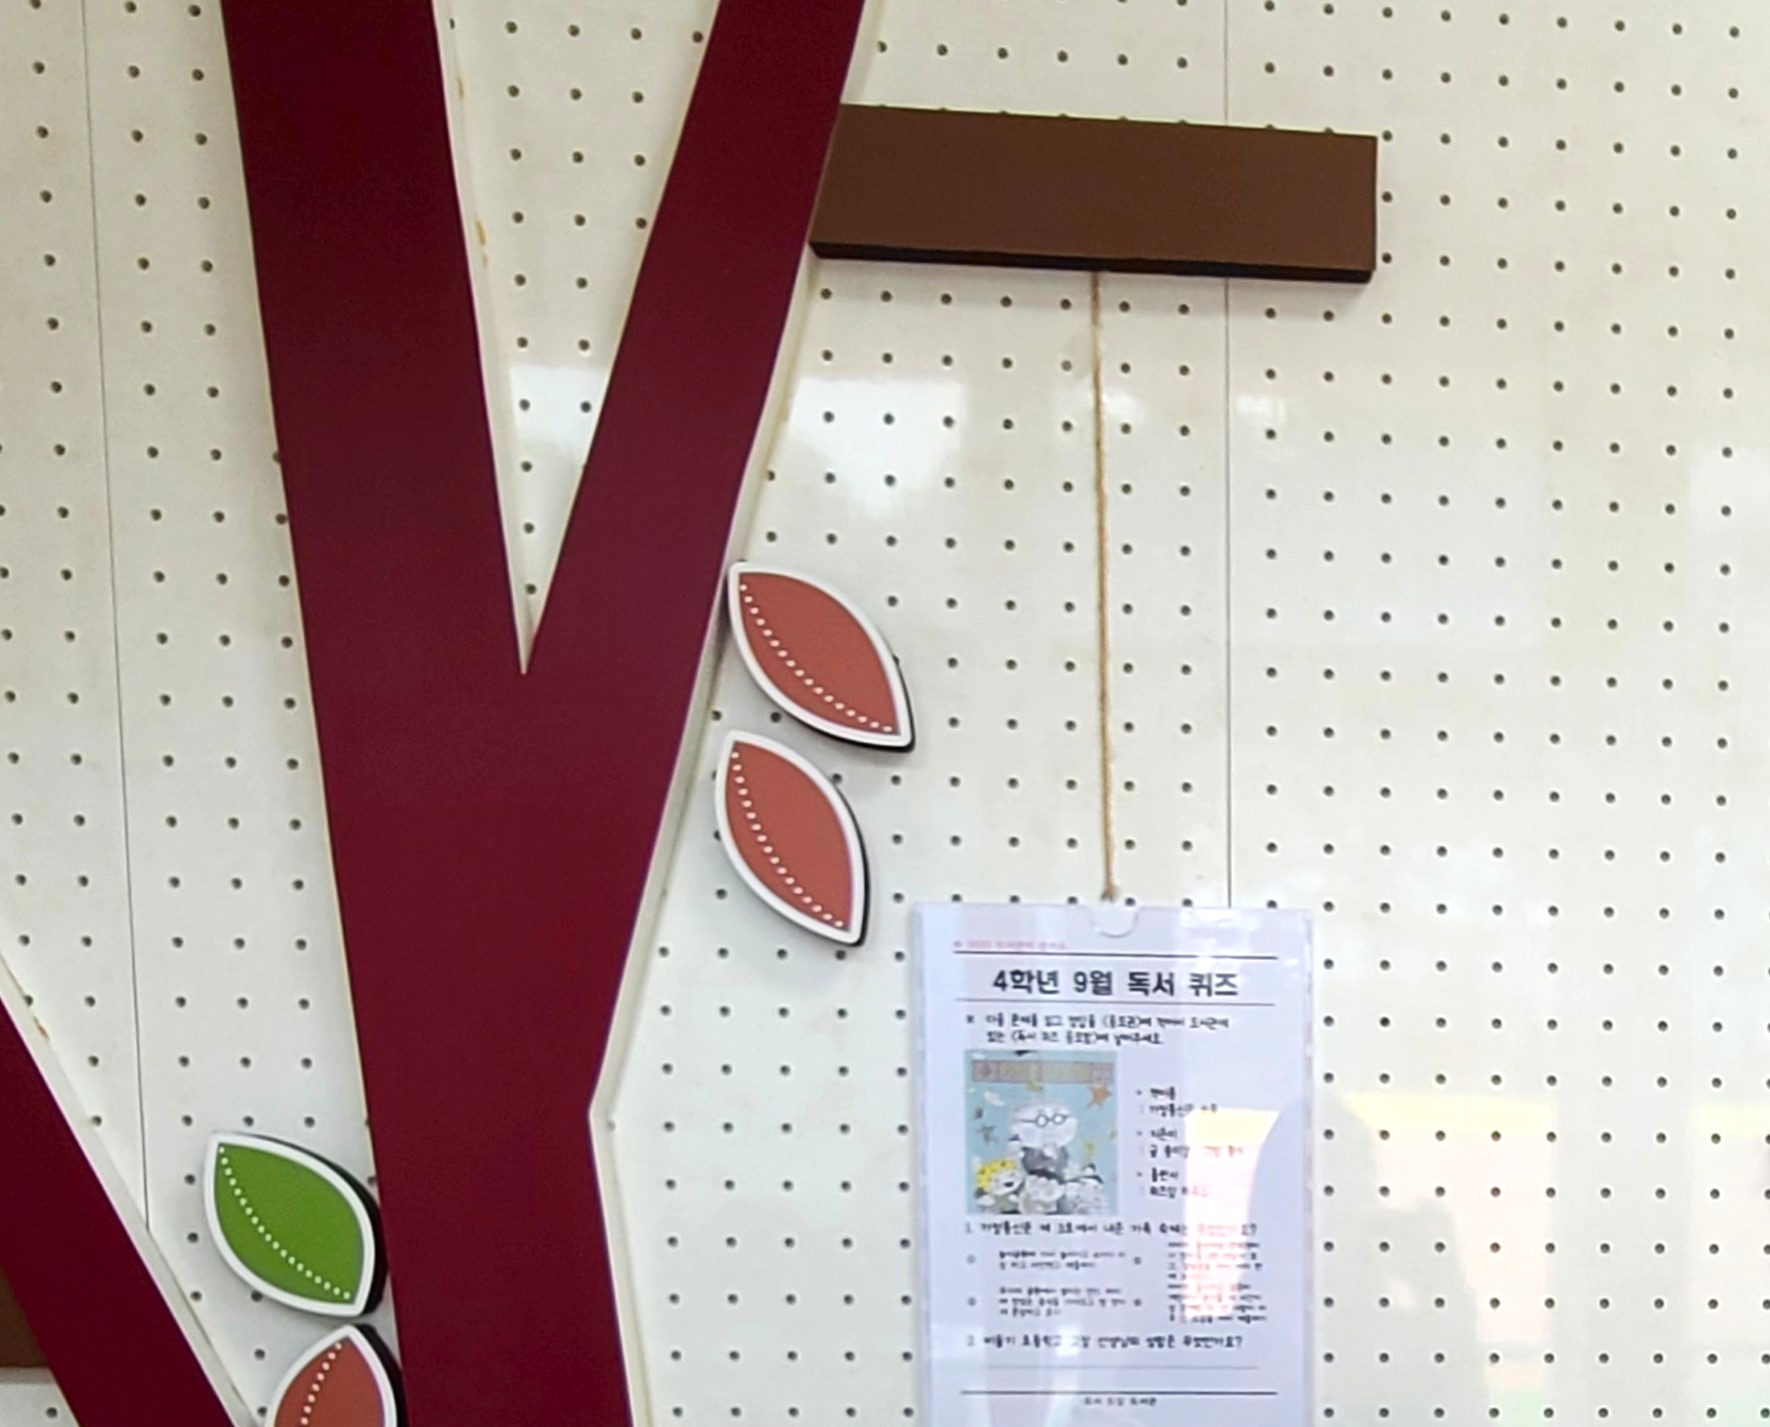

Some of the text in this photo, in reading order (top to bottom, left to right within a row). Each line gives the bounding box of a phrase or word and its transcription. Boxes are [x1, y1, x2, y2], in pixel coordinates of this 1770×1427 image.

[993, 970, 1239, 997] 4학년 9월 독서 퀴즈
